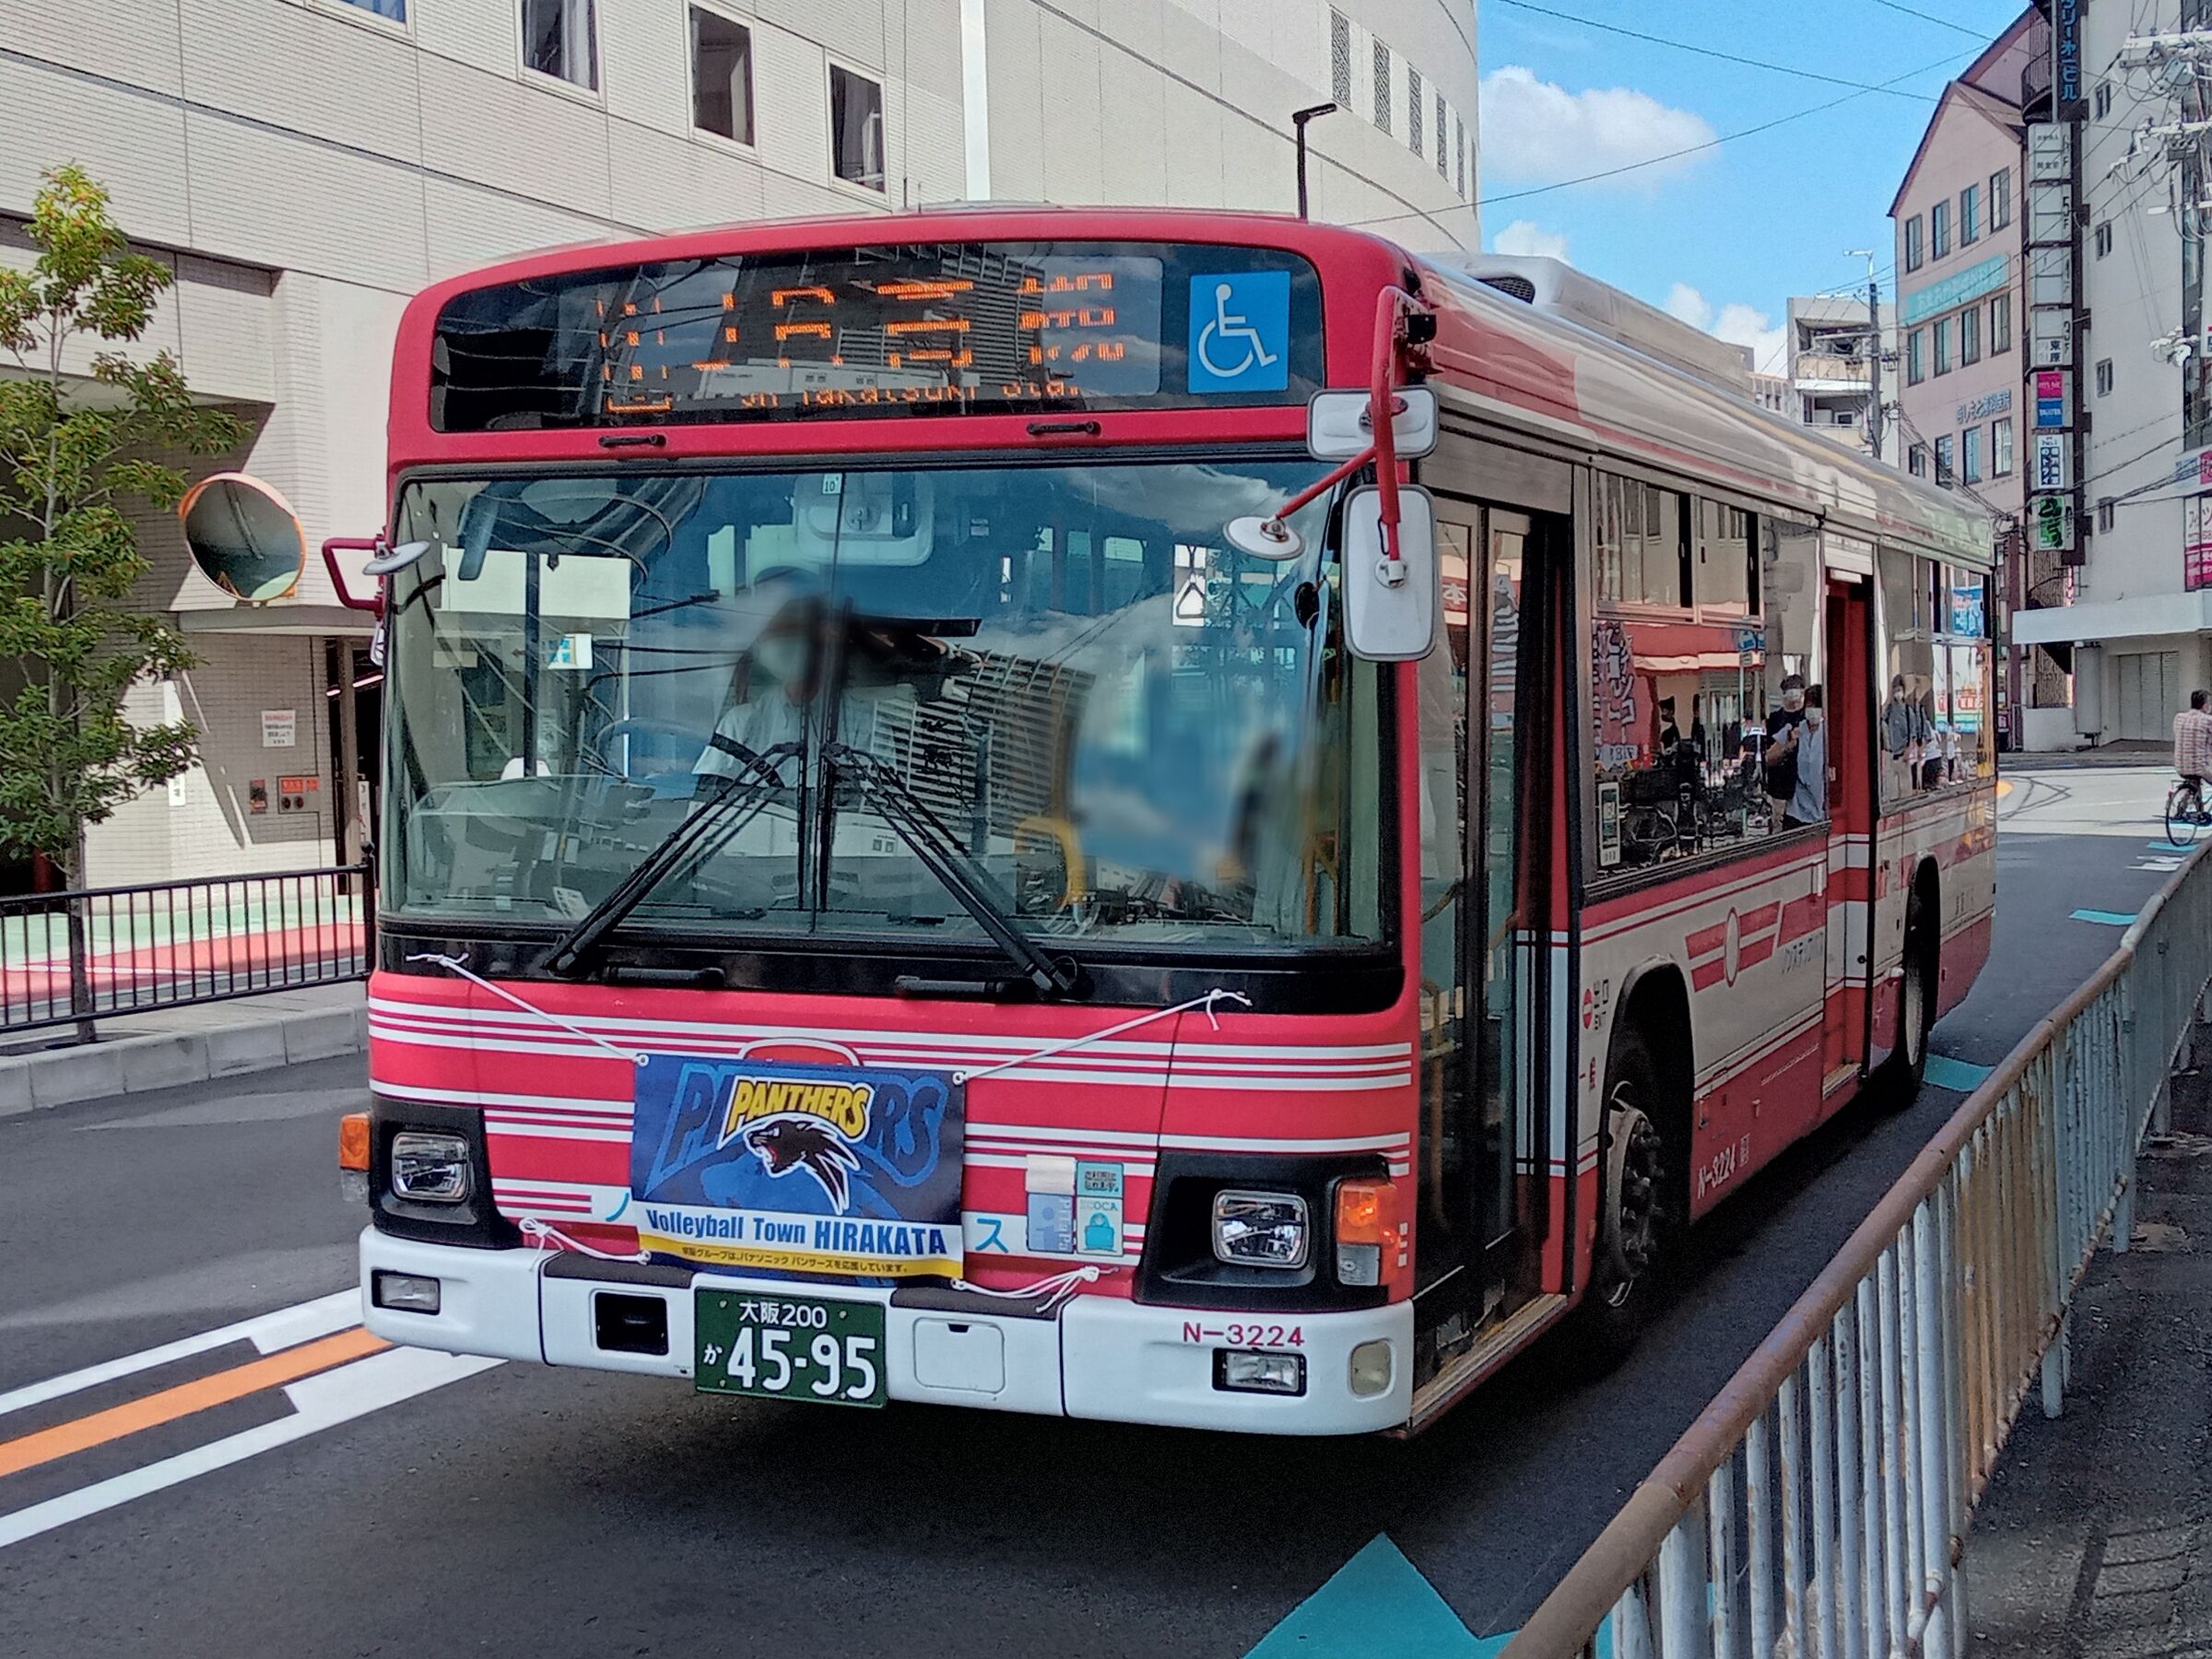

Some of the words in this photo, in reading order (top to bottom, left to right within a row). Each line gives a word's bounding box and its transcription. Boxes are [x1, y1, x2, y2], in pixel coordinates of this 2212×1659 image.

[726, 1079, 869, 1137] PANTHERS
[646, 1209, 744, 1239] Volleyball
[753, 1218, 806, 1244] Town
[814, 1219, 947, 1255] HIRAKATA
[739, 1300, 827, 1328] 大阪200
[1183, 1322, 1305, 1347] N-3224
[703, 1343, 723, 1365] か
[727, 1327, 876, 1400] 45-95
